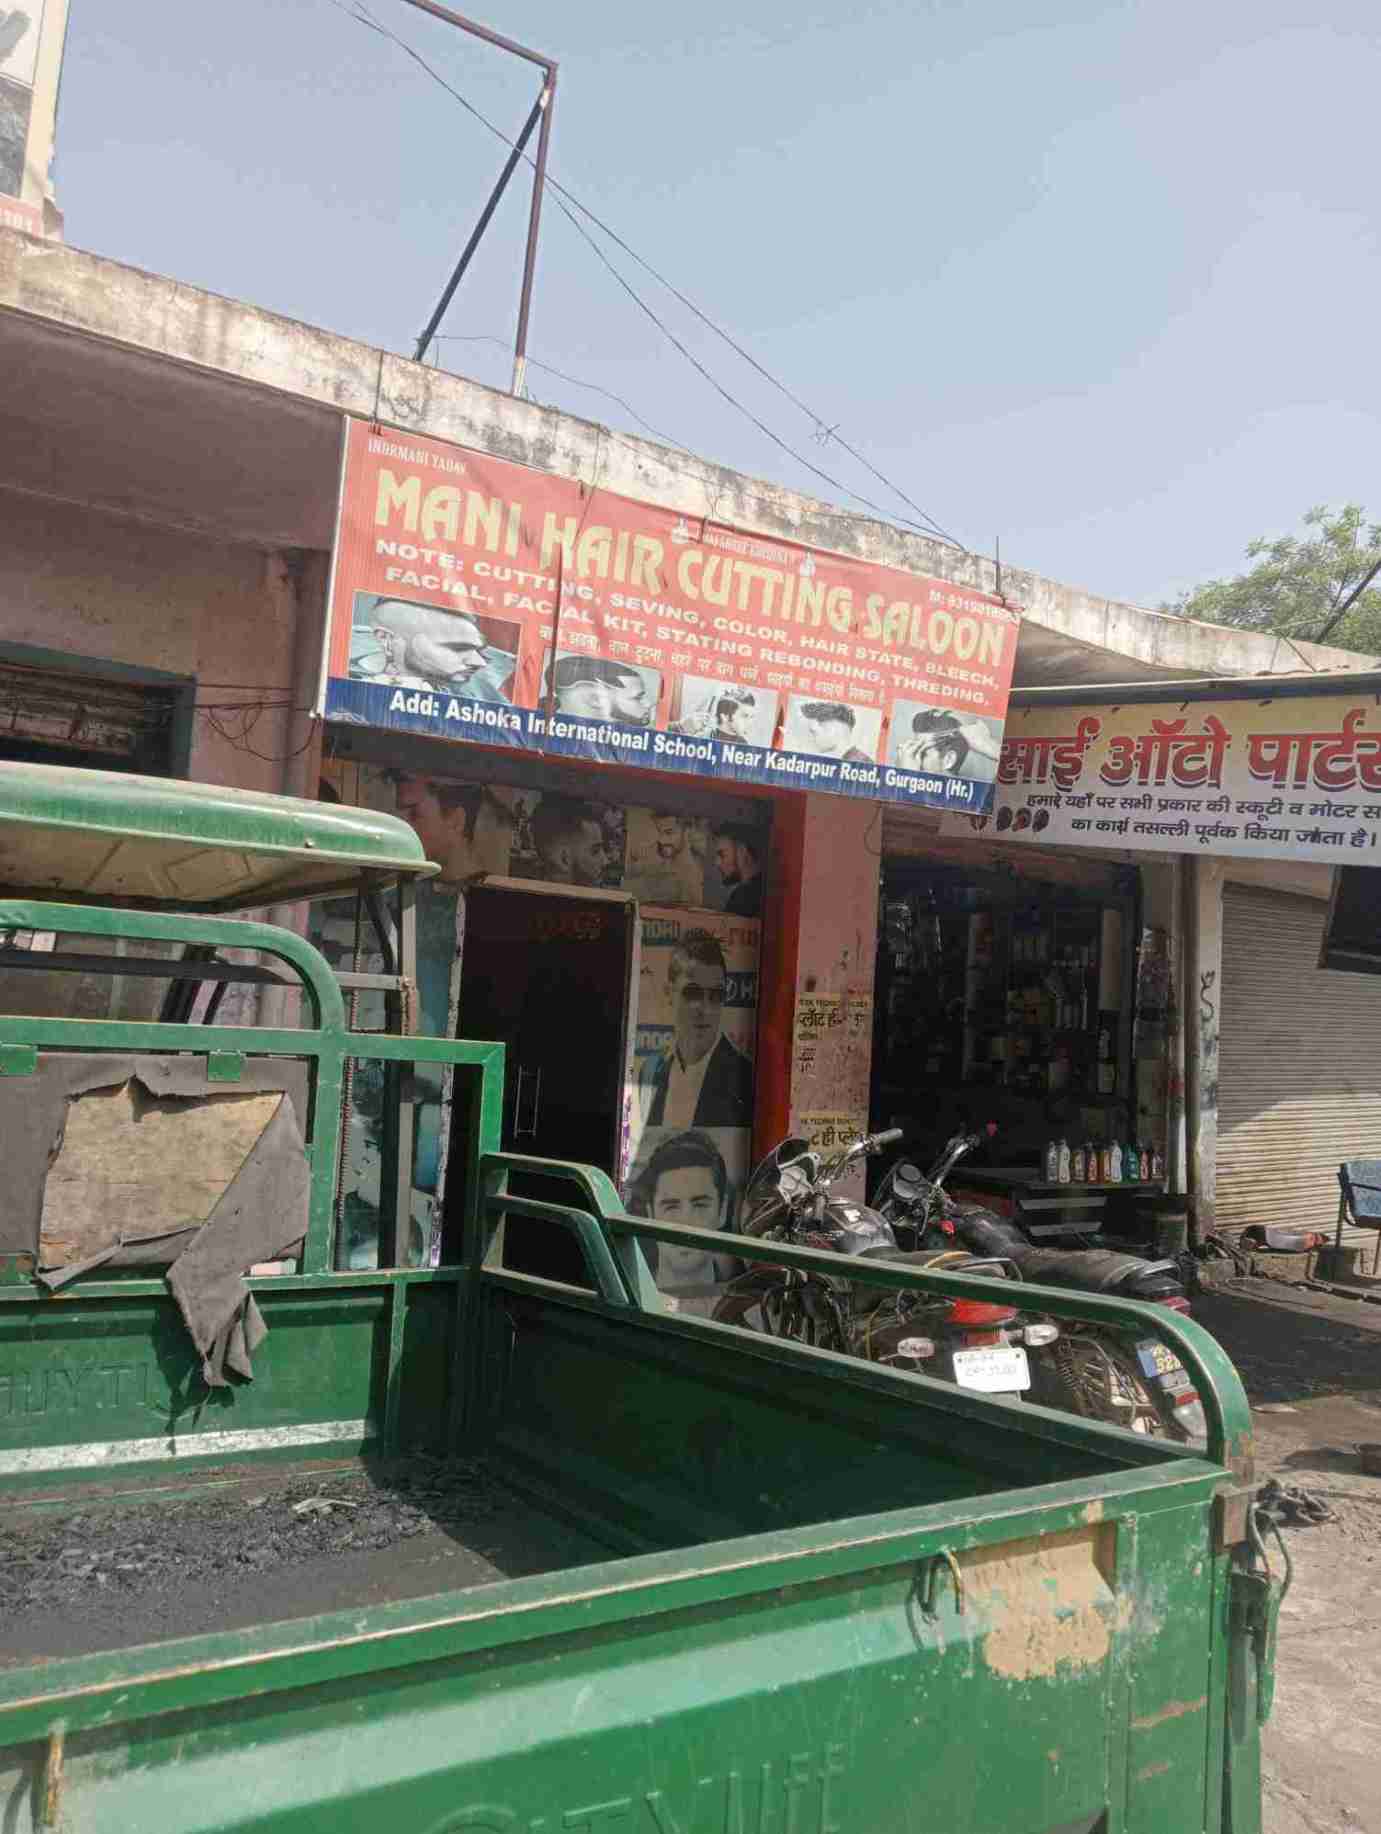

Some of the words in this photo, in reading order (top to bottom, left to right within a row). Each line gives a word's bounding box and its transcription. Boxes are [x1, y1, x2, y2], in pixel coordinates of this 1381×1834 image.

[374, 467, 523, 558] MANI
[539, 511, 666, 596] HAIR
[676, 549, 853, 634] CUTTING
[863, 593, 1009, 668] SALOON
[376, 539, 464, 571] NOTE:
[609, 592, 706, 628] SEVING,
[713, 617, 793, 647] COLOR,
[799, 636, 849, 657] HAIR
[855, 648, 918, 673] STATE,
[384, 567, 494, 606] FACIAL,
[603, 615, 648, 641] KIT,
[656, 626, 753, 658] STATING
[760, 648, 884, 686] REBONDING,
[893, 676, 989, 706] THREDING,
[390, 689, 439, 717] Add:
[446, 697, 522, 734] Ashoka
[528, 712, 650, 752] International
[653, 734, 717, 765] School,
[722, 748, 760, 769] Near
[765, 752, 836, 779] Kadarpur
[840, 762, 881, 788] Road,
[885, 768, 943, 796] Gurgaon
[946, 780, 974, 802] (Hr.)
[1100, 714, 1233, 790] ऑटो
[1071, 818, 1091, 833] का
[1133, 819, 1190, 837] तसल्ली
[1194, 820, 1239, 844] पूर्वक
[1243, 822, 1290, 843] किया
[1096, 796, 1116, 810] पर
[1120, 793, 1153, 810] सभी
[1157, 798, 1202, 813] प्रकार
[1206, 795, 1232, 813] की
[1236, 797, 1284, 821] स्कूटी
[1289, 802, 1304, 816] व
[1310, 800, 1359, 818] मोटर
